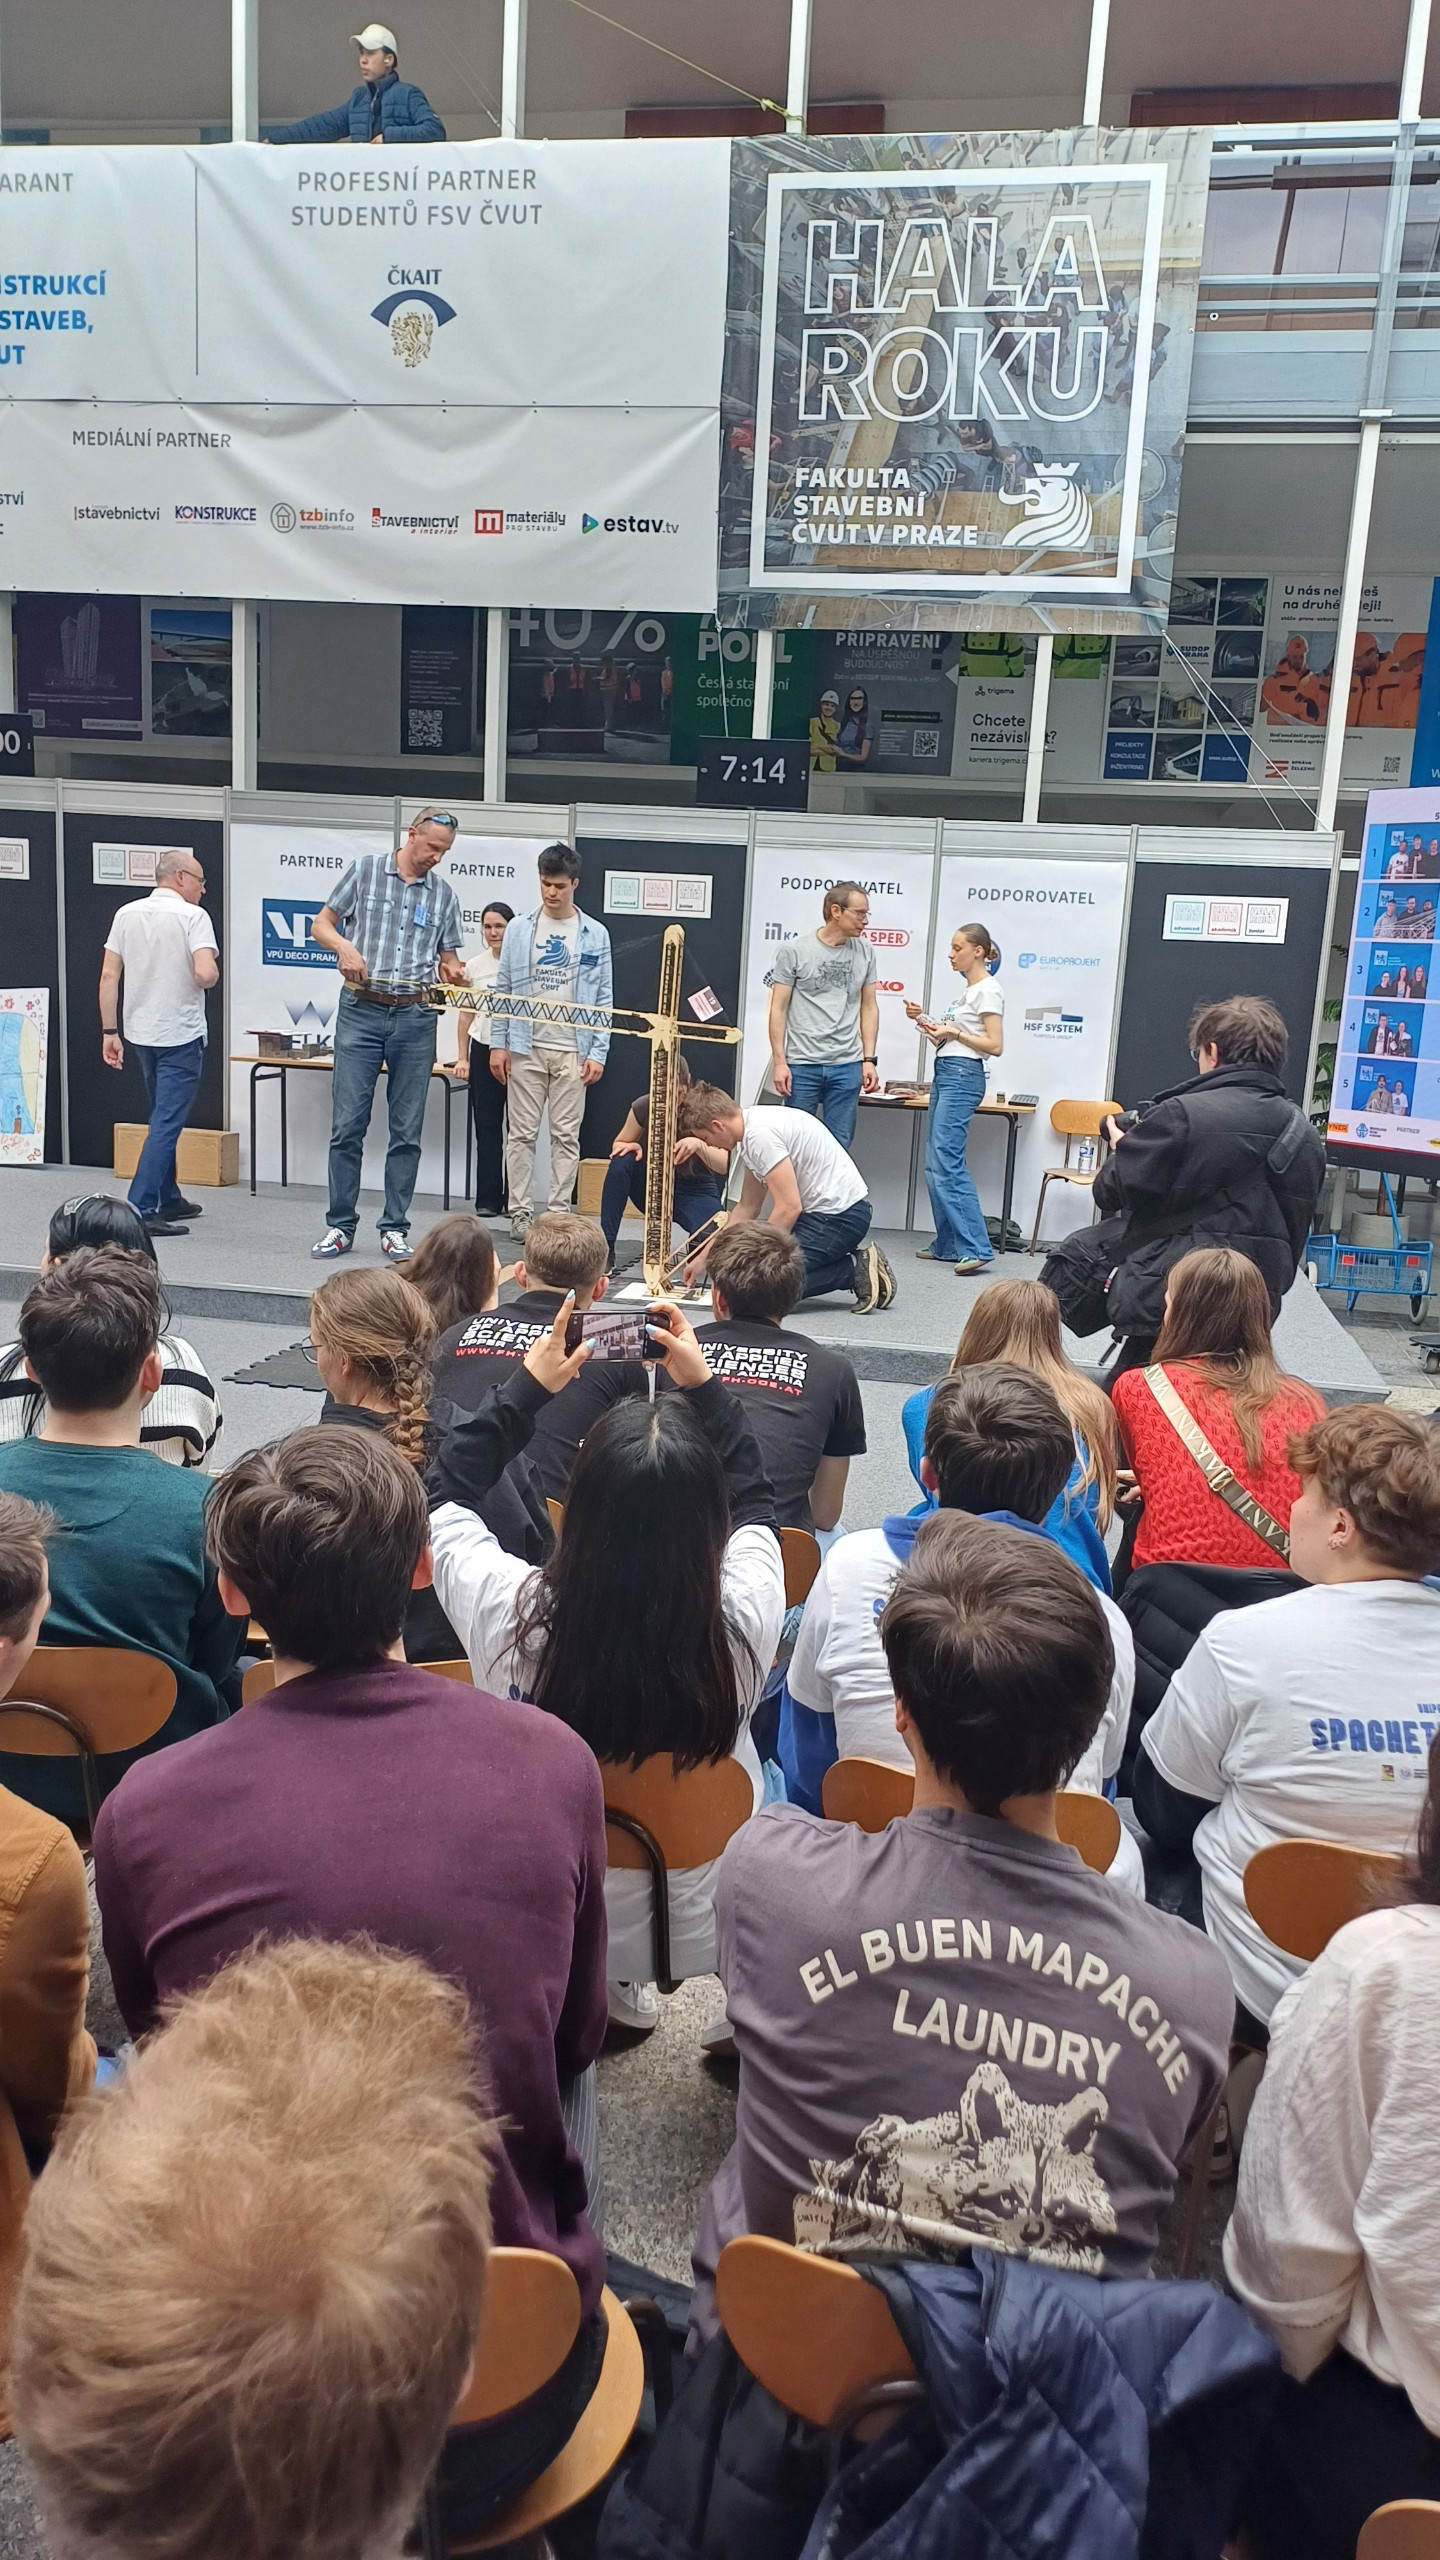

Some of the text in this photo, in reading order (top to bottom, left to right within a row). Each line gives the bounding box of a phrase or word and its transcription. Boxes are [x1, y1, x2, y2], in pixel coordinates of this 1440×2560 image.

[297, 166, 537, 192] PROFESNÍ PARTNER
[291, 199, 543, 226] STUDENTŮ FSV ČVUT
[804, 215, 1110, 314] HALA
[0, 270, 107, 296] STRUKCÍ
[387, 265, 443, 286] ČKAIT
[799, 326, 1110, 422] ROKU
[72, 428, 232, 448] MEDIÁLNÍ PARTNER
[795, 467, 912, 489] FAKULTA
[793, 490, 926, 517] STAVEBNÍ
[175, 505, 257, 521] KONSTRUKCE
[299, 508, 355, 522] tzbinfo
[506, 511, 566, 526] materiály
[604, 515, 680, 534] estav.tv
[792, 518, 979, 546] ČVUT V PRAZE
[1284, 584, 1379, 597] U nás neeš
[1282, 601, 1298, 609] na
[1302, 600, 1340, 610] druhé
[698, 631, 793, 664] POL
[697, 694, 753, 708] společno
[972, 713, 1026, 727] Chcete
[0, 729, 21, 755] 0
[970, 729, 1058, 744] nezávislt?
[720, 755, 786, 784] 7:14
[968, 756, 1027, 765] kariera.trigema.c
[280, 854, 344, 869] PARTNER
[450, 863, 515, 878] PARTNER
[781, 877, 904, 894] PODPOVATEL
[967, 887, 1096, 905] PODPOROVATEL
[860, 931, 903, 943] SPER
[285, 950, 309, 961] DECO
[1040, 956, 1101, 968] EUROPROJEKT
[1024, 1023, 1083, 1034] HSF SYSTEM
[462, 1330, 536, 1345] SCIEN
[706, 1358, 806, 1380] CIENCES
[720, 1351, 808, 1370] APPLIED
[736, 1371, 804, 1388] AUSTRIA
[1310, 1718, 1440, 1754] SPAGHET
[799, 1918, 1193, 2097] EL BUEN MAPACHE
[892, 1988, 1122, 2086] LAUNDRY
